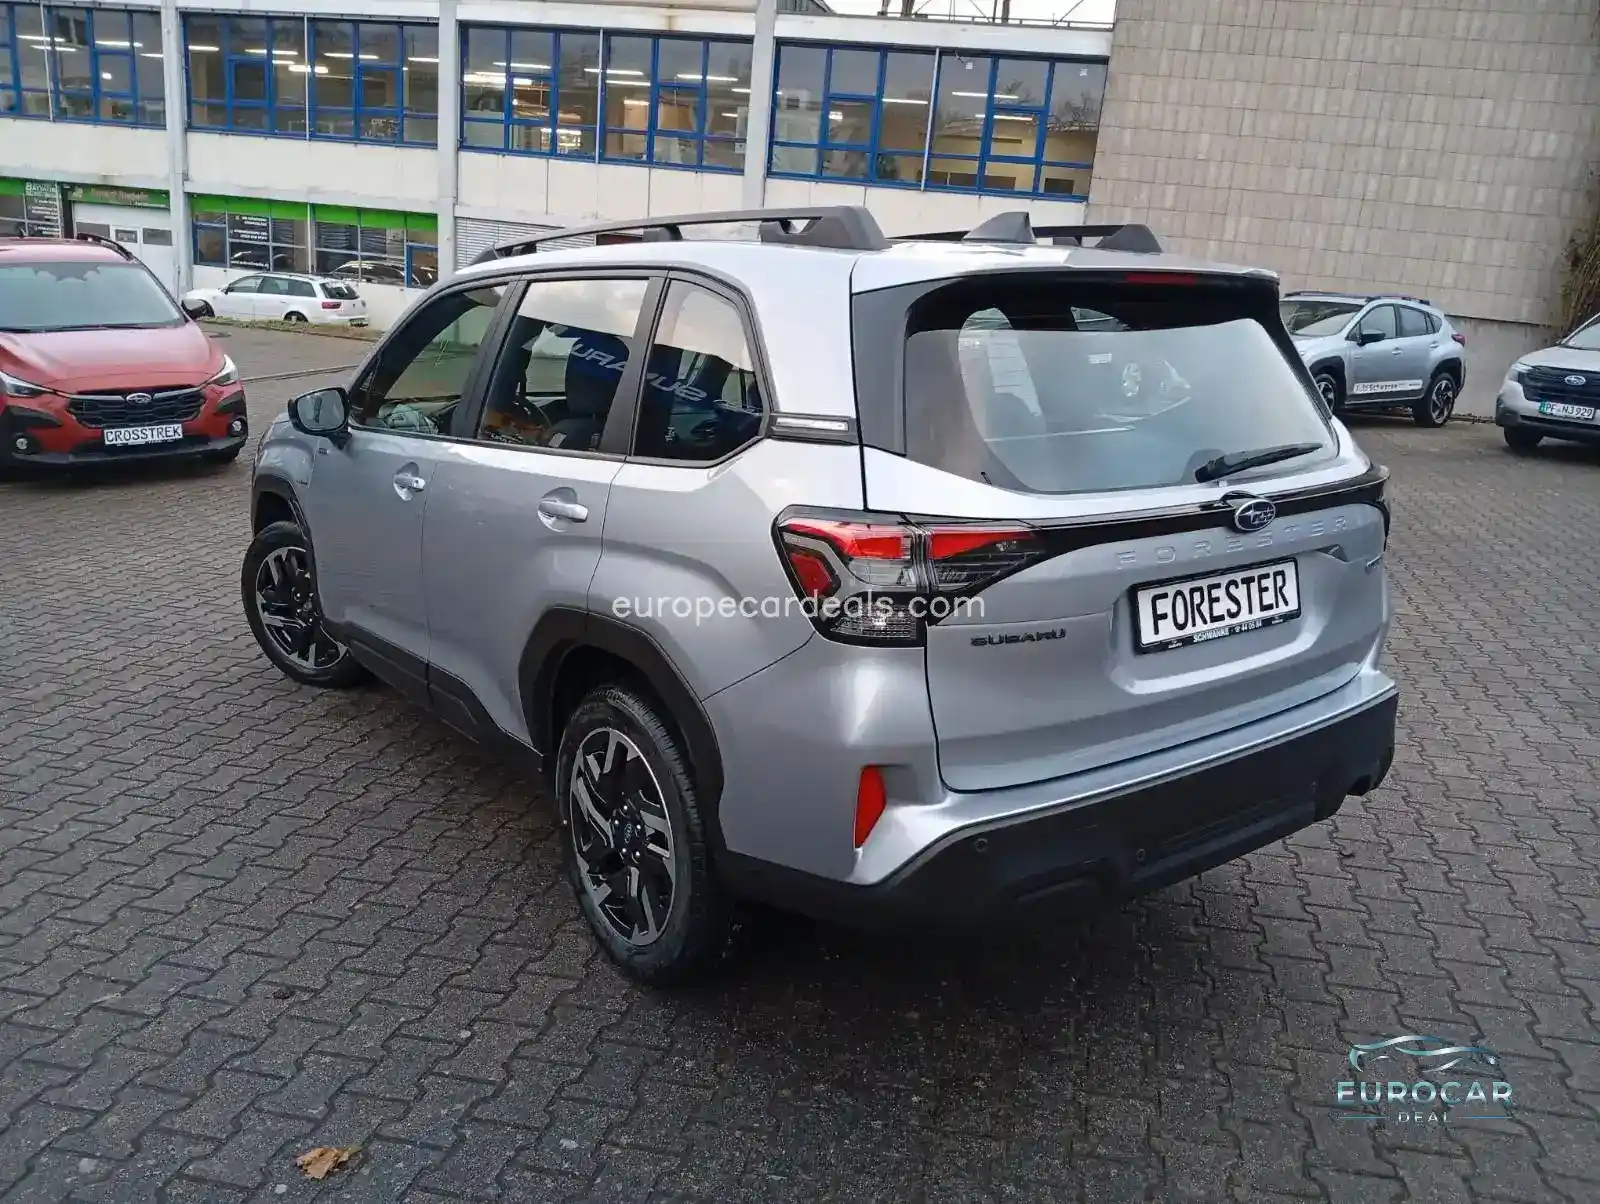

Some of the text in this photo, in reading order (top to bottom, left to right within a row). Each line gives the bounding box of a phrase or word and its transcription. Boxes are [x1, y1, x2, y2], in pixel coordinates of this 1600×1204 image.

[105, 425, 182, 443] CROSSTREK
[1117, 515, 1348, 565] FORESTER
[1150, 569, 1290, 636] FORESTER
[970, 627, 1067, 647] SUBARU
